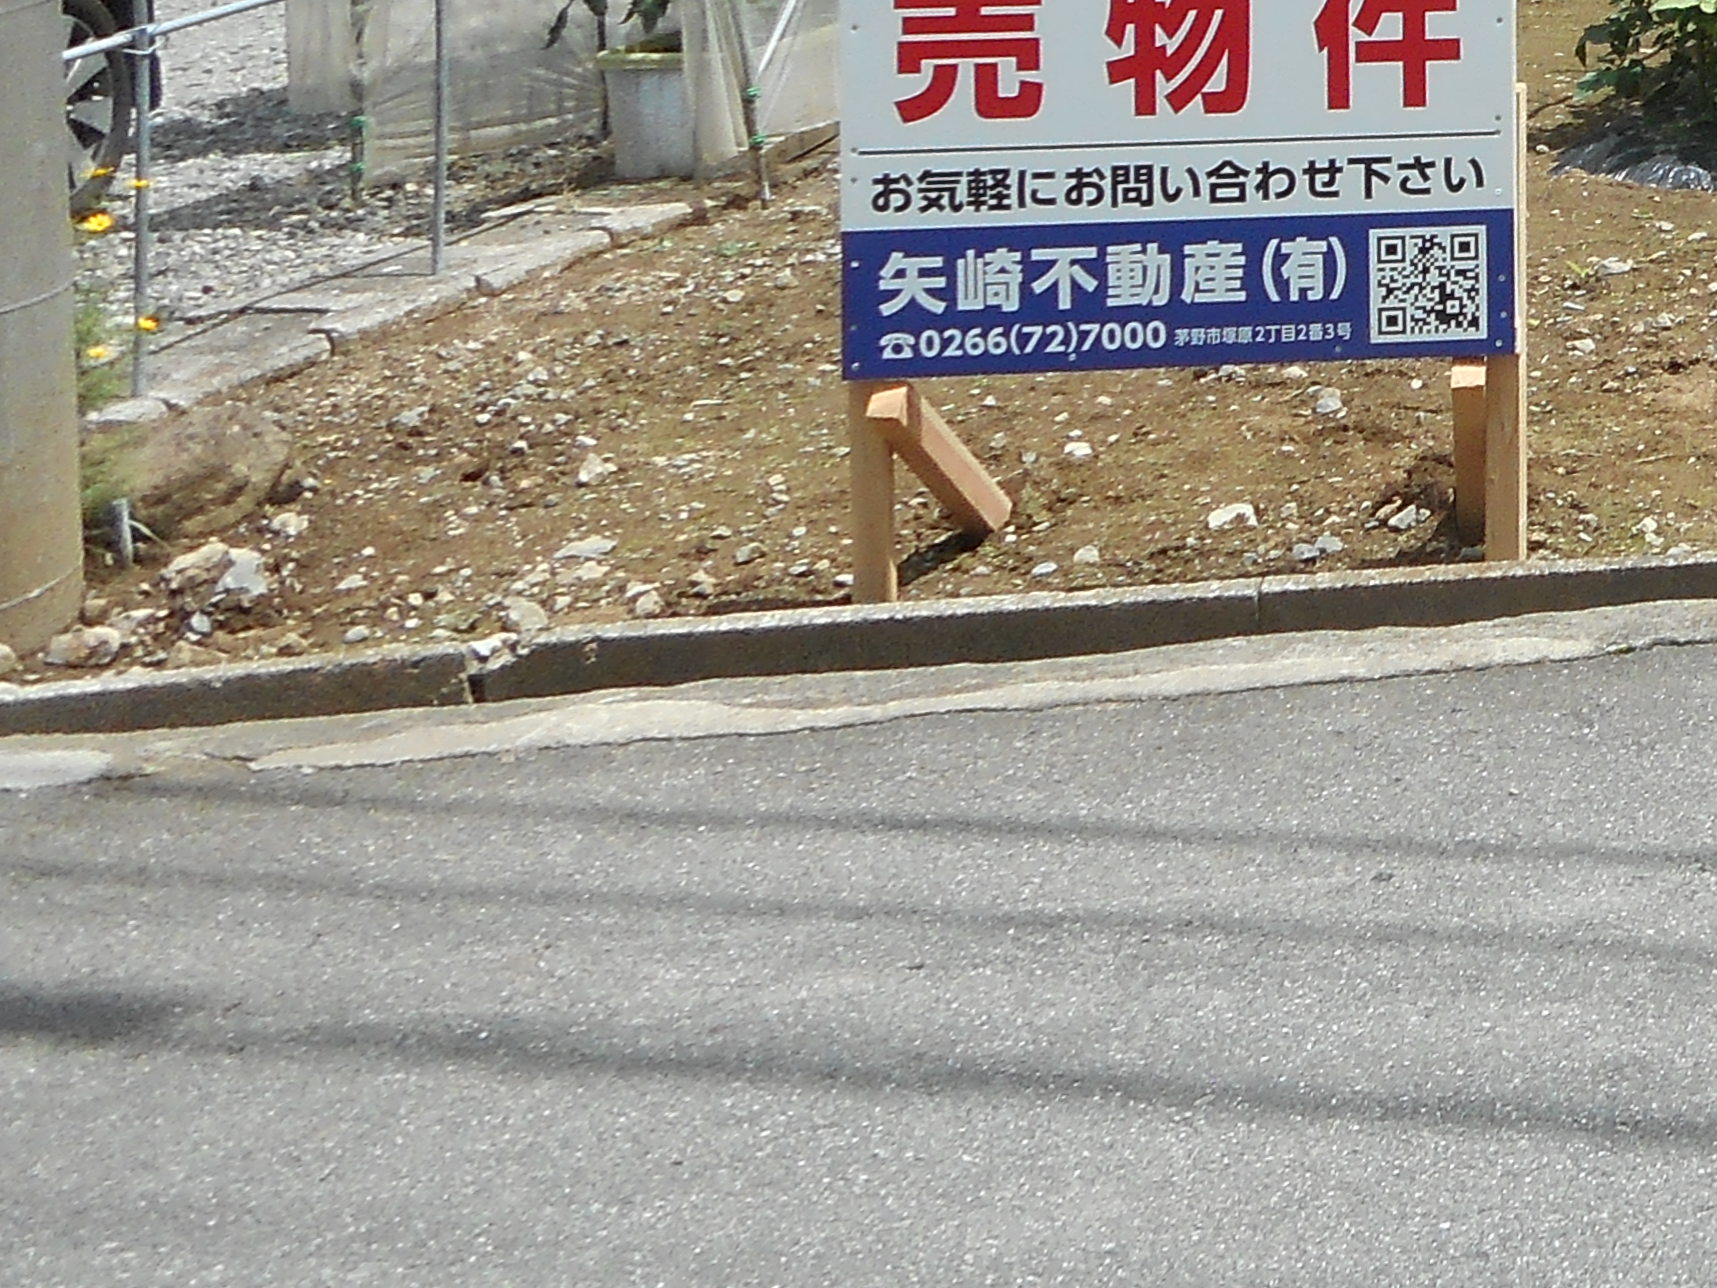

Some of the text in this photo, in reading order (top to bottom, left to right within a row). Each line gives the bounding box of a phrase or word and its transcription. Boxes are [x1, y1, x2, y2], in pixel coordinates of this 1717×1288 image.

[870, 154, 1486, 214] お気軽にお問い合わせ下さい
[919, 321, 1167, 358] 0266(72)7000
[1173, 322, 1353, 347] 茅野市塚原2丁目2番3号
